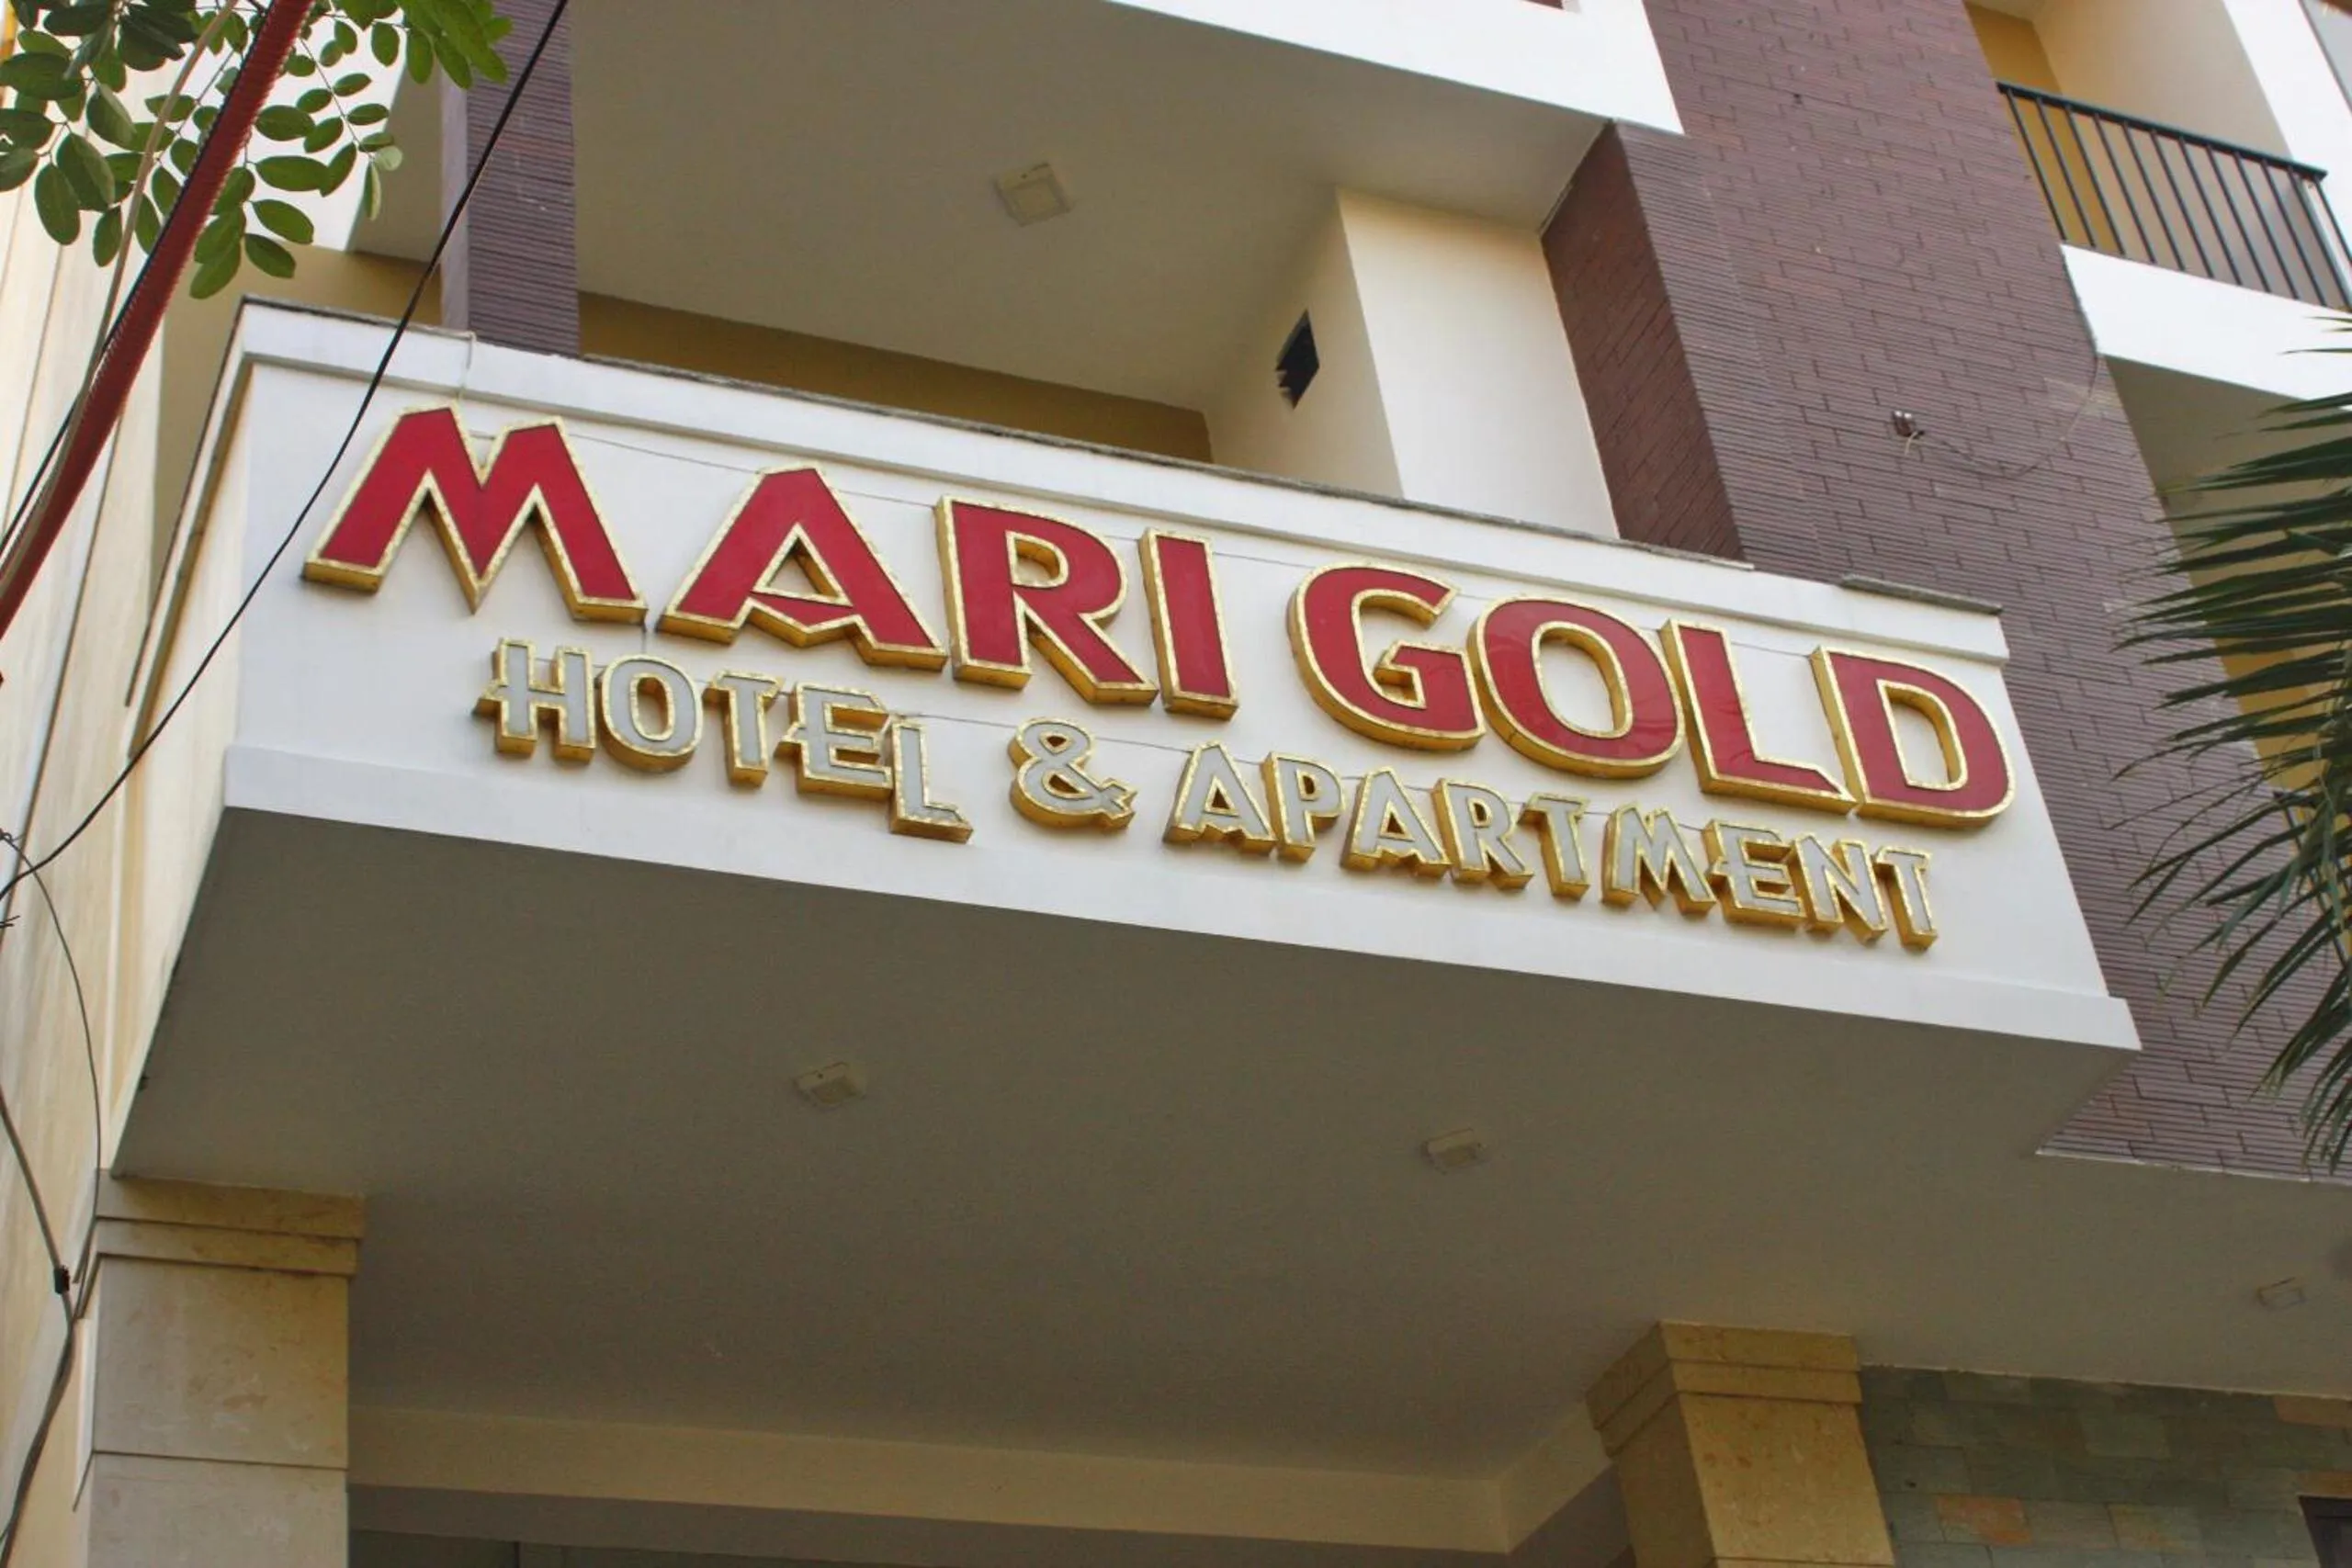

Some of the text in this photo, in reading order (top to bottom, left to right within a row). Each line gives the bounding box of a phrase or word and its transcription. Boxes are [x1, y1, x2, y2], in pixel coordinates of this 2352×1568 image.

[471, 636, 1938, 951] HOTEL & APARTMENT
